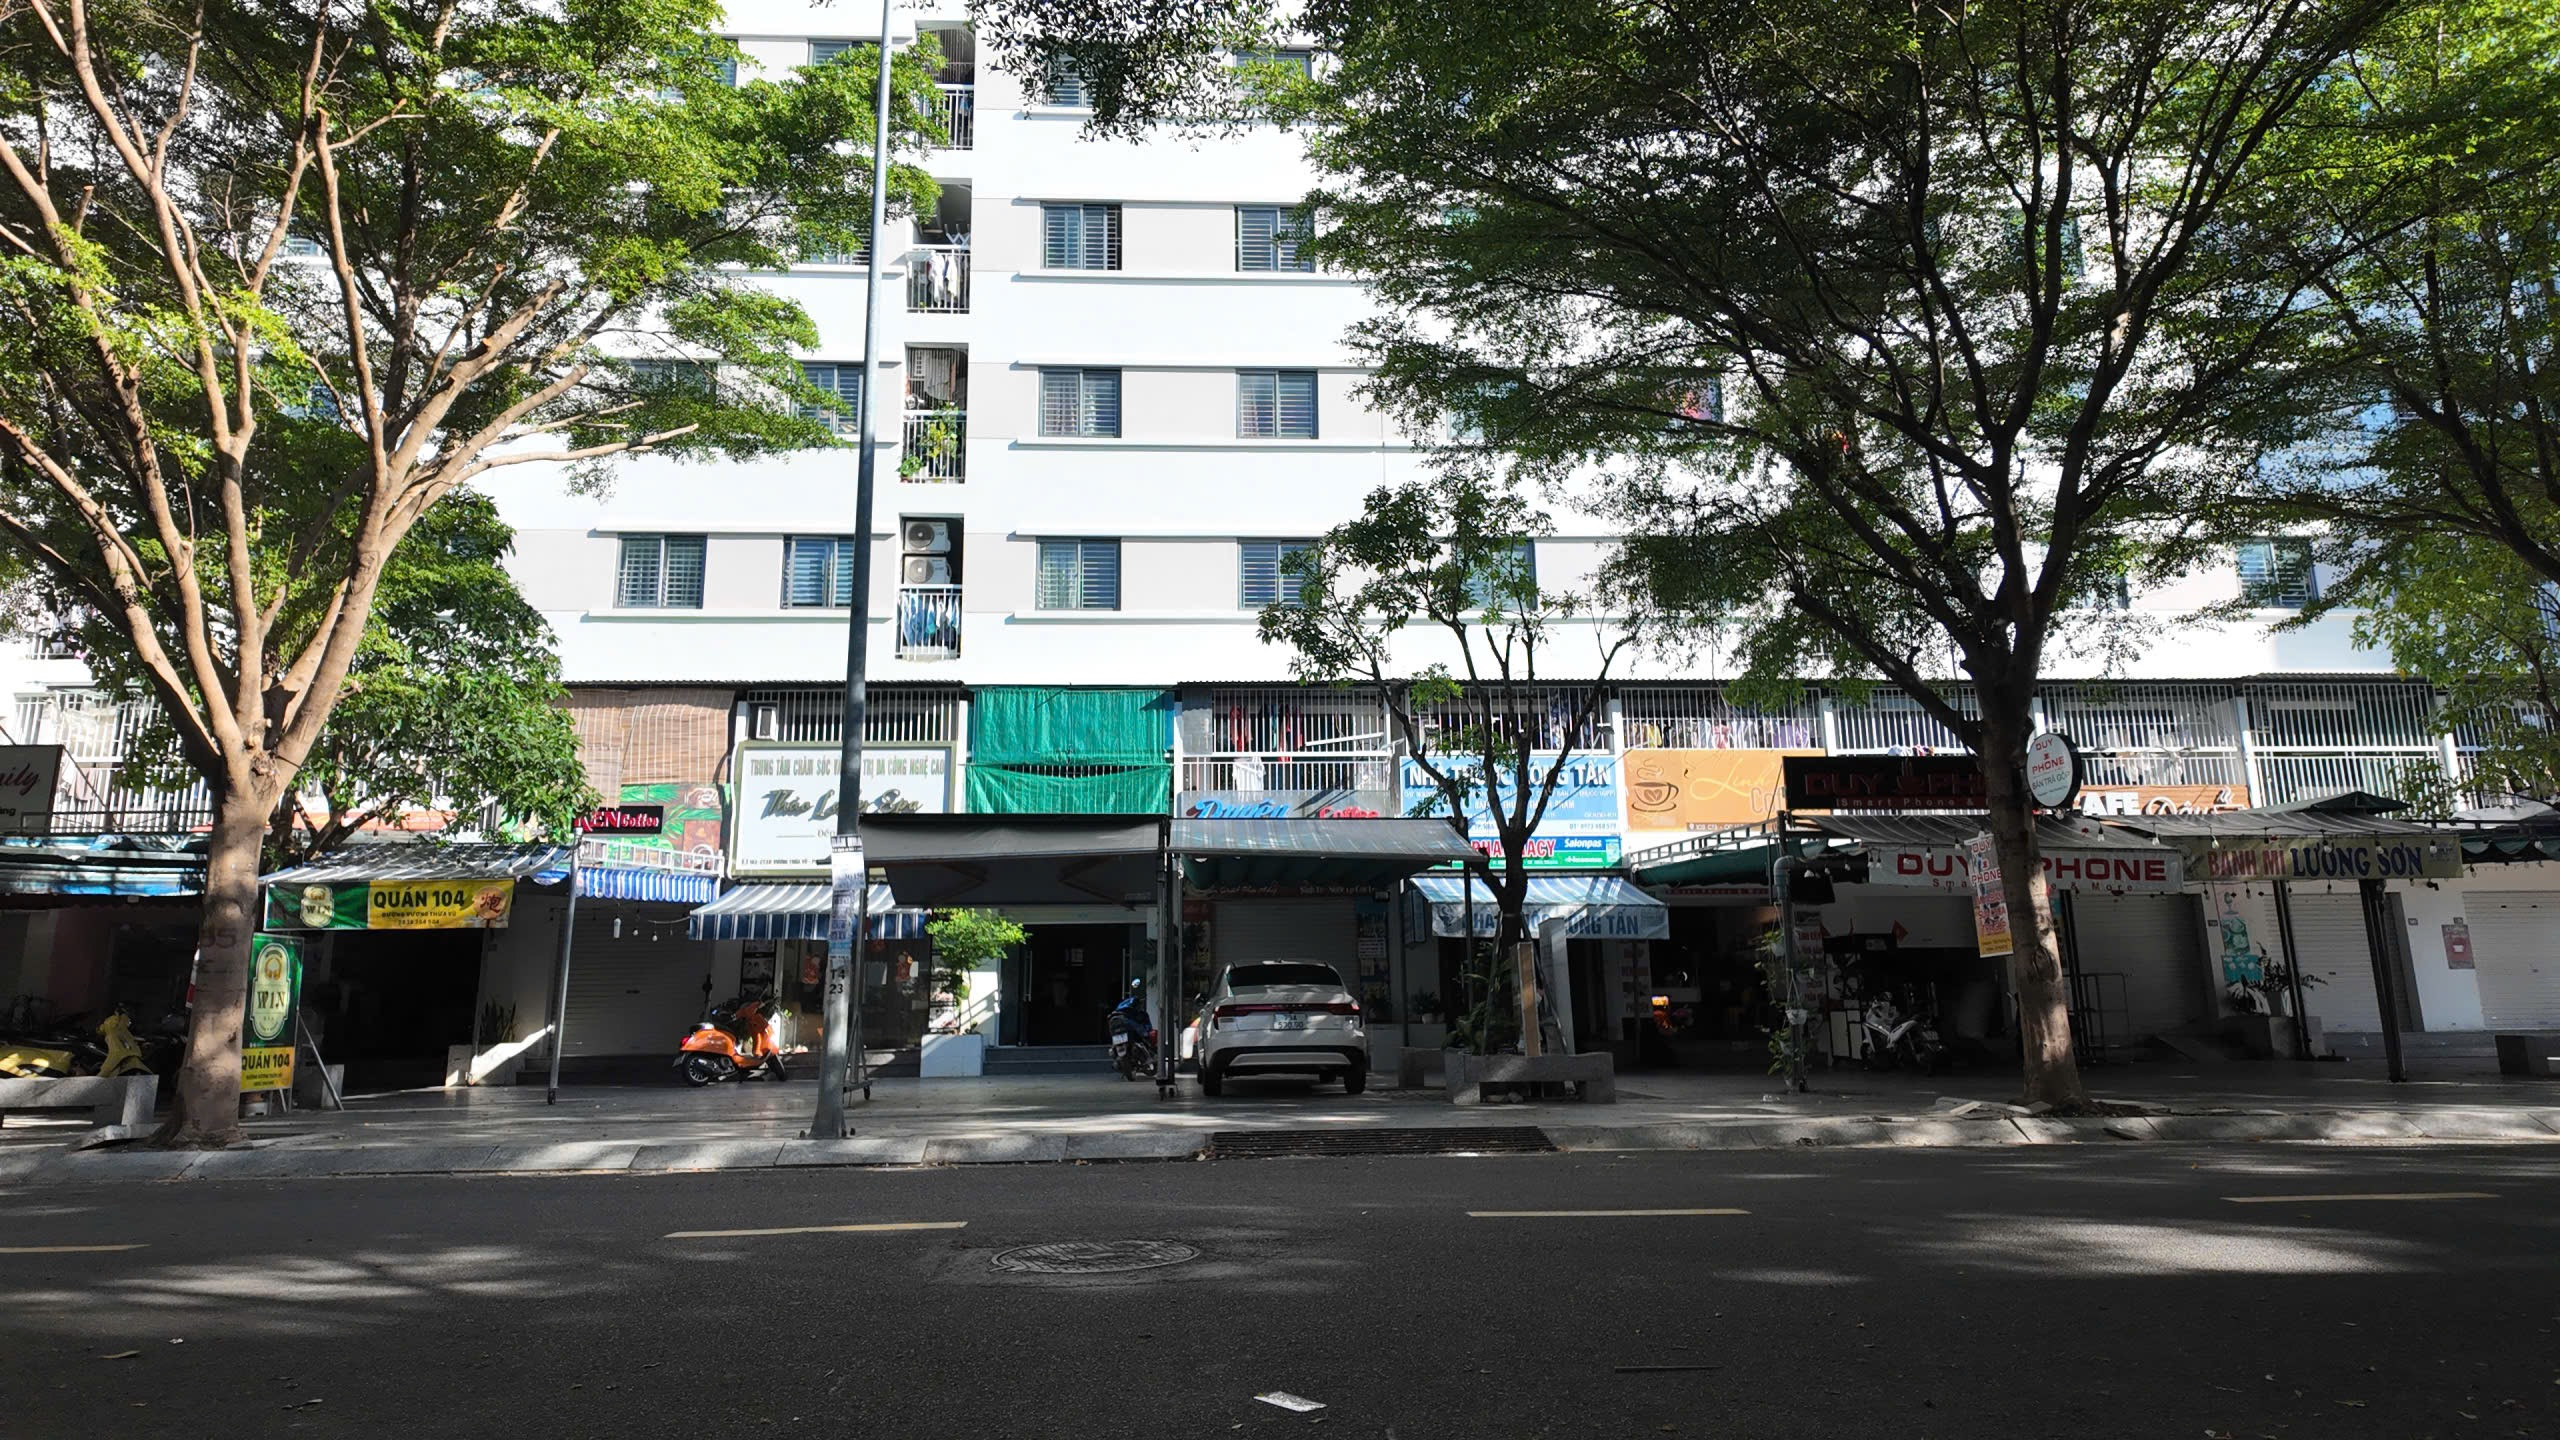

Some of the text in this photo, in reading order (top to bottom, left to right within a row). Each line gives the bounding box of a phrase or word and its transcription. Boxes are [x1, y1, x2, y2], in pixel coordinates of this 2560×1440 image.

[2036, 737, 2053, 751] DUY
[750, 759, 774, 776] TRUNG
[816, 754, 831, 776] SÓC
[931, 759, 945, 776] CAO
[1573, 758, 1612, 786] TÂN
[2032, 755, 2065, 775] PHONE
[0, 763, 39, 797] ily
[1804, 773, 1880, 796] DUY
[1903, 797, 1955, 807] Phone
[2072, 791, 2142, 816] AFE
[621, 813, 660, 829] Coffee
[1471, 838, 1603, 859] PHAACY Salonpas
[1972, 839, 1993, 853] DUY
[2208, 843, 2258, 877] BÁNH
[2374, 842, 2424, 877] SƠN
[1971, 868, 2001, 884] PHONE
[373, 886, 465, 908] QUÁN 104
[1605, 911, 1639, 935] TÂN
[830, 968, 846, 980] T4
[829, 983, 844, 995] 23
[257, 991, 286, 1009] WIN
[241, 1051, 290, 1071] QUÁN 104
